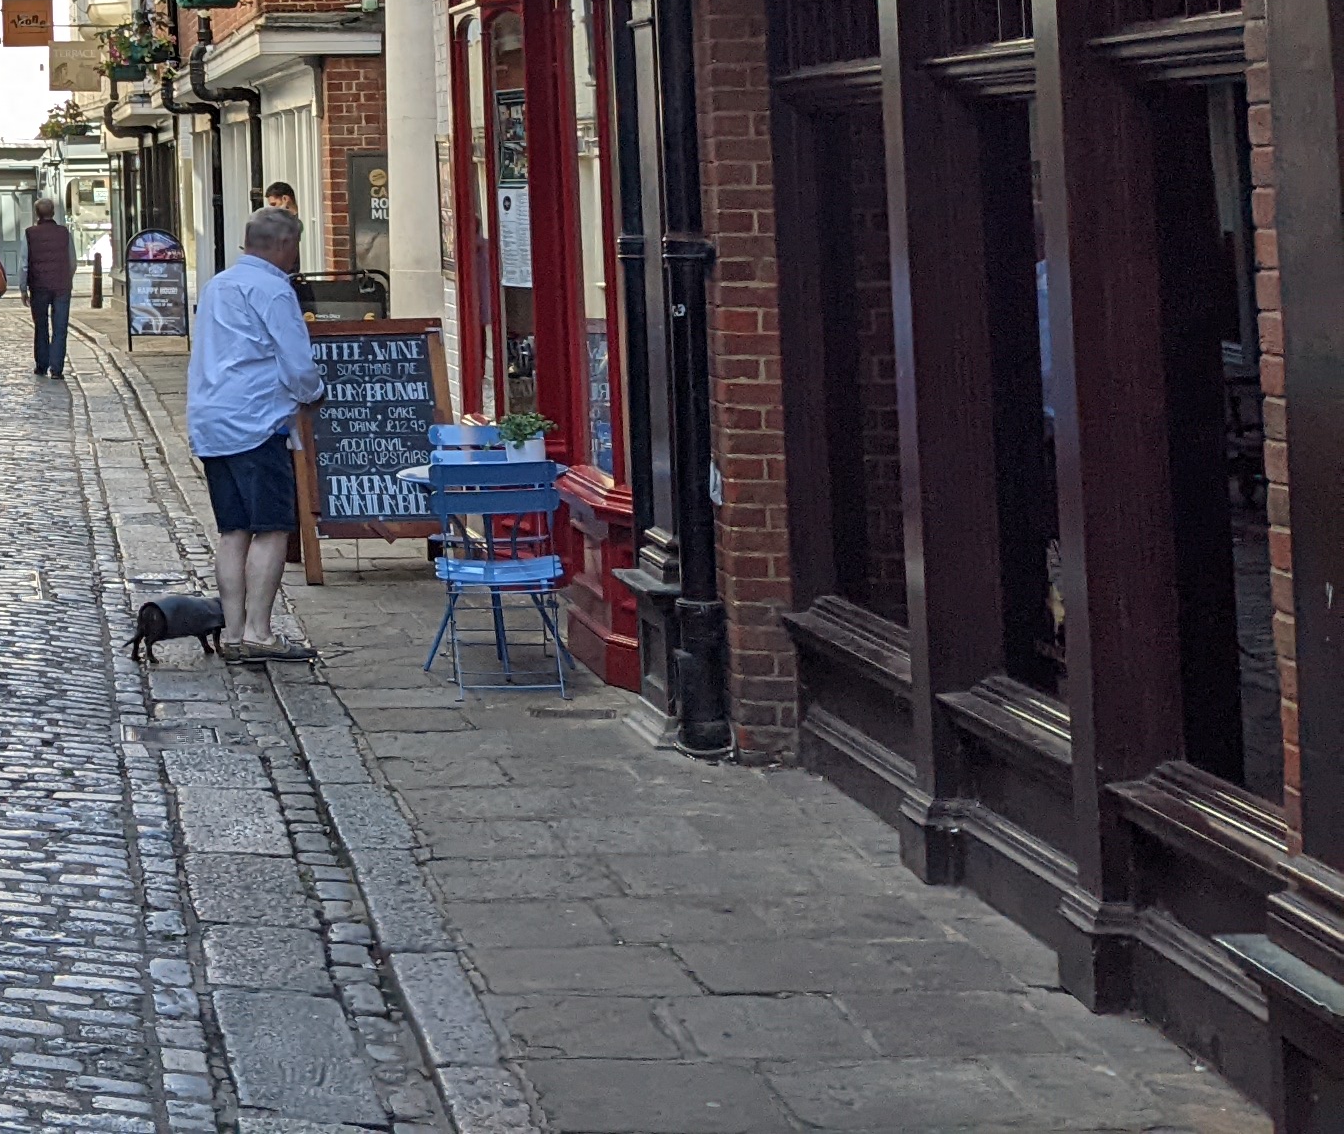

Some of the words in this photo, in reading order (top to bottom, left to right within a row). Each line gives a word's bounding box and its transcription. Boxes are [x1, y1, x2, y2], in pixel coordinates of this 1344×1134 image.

[53, 49, 96, 58] TERRACE
[371, 340, 424, 360] WINE
[388, 406, 416, 419] CAKE
[331, 420, 341, 433] &
[349, 421, 379, 432] DRINK
[339, 437, 407, 452] ADDITIONAL
[328, 493, 431, 516] AVAILABLE
